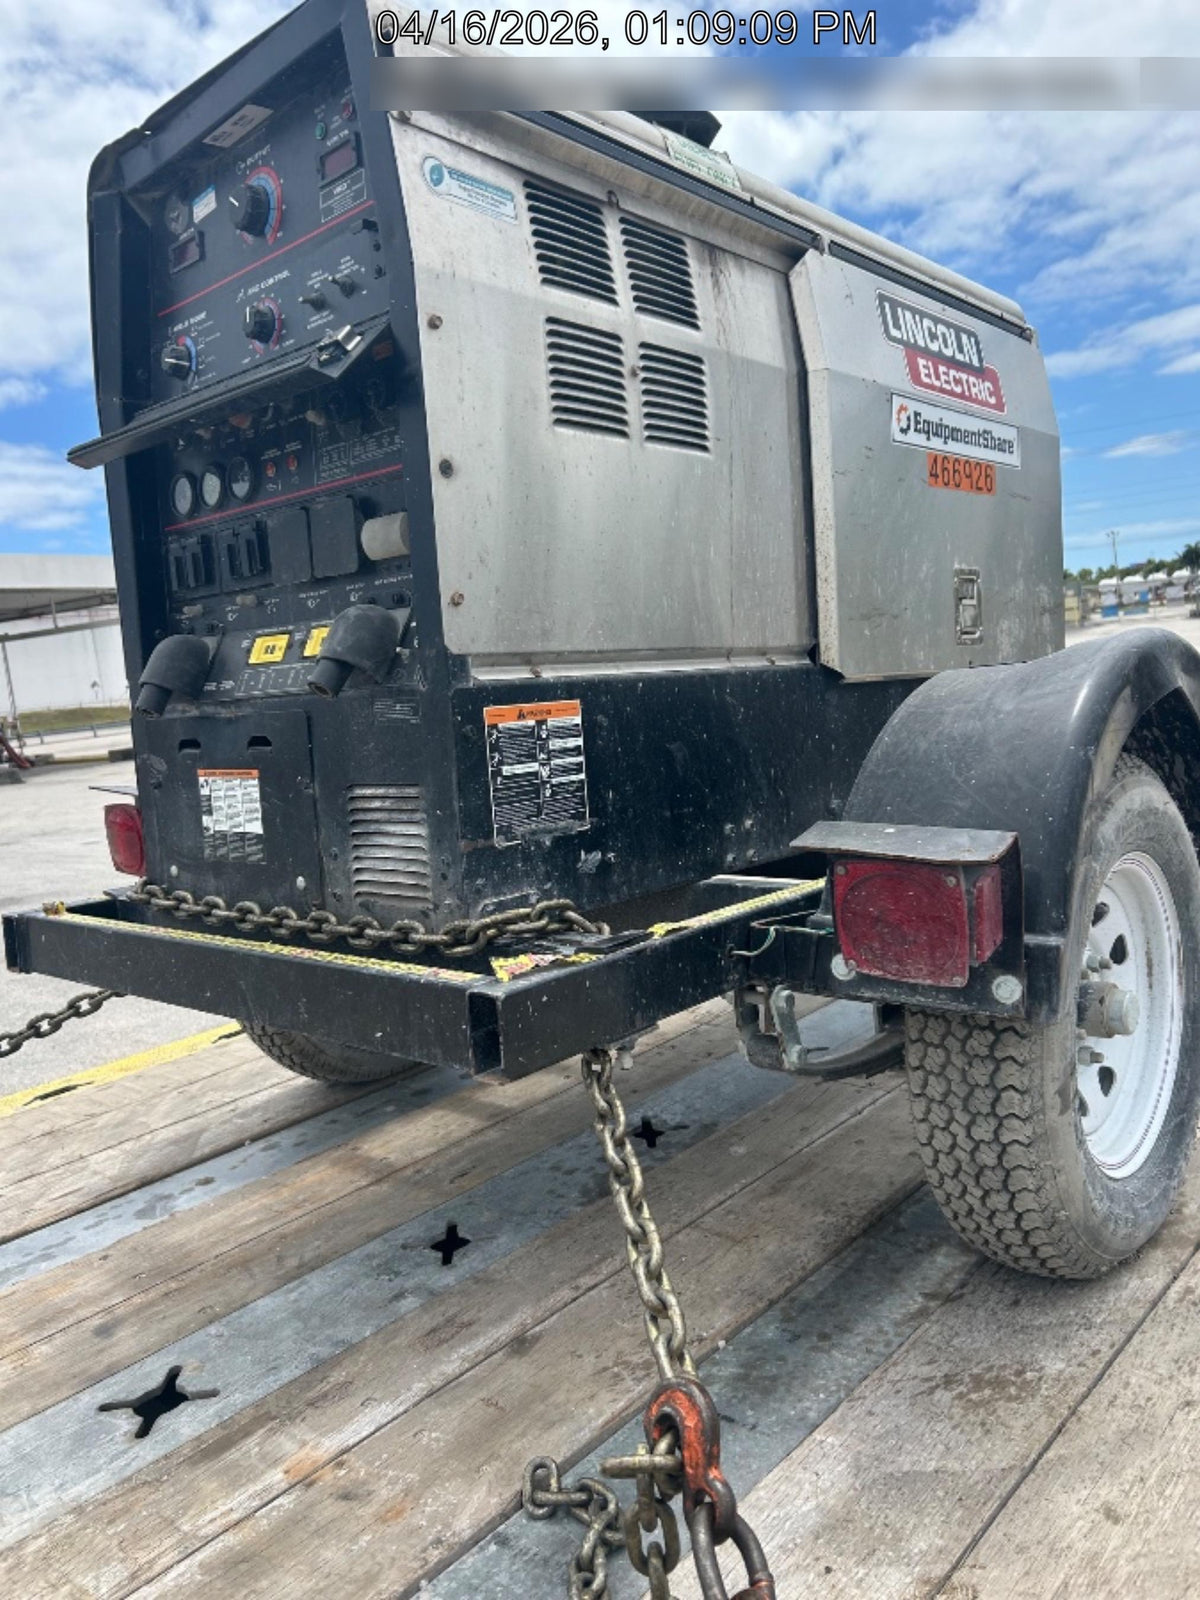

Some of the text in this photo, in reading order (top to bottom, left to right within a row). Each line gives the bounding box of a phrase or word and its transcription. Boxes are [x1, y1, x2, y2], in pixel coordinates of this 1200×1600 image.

[883, 301, 981, 367] LINCOLN
[917, 357, 996, 405] ELECTRIC
[913, 410, 1015, 455] EquipmentShare
[929, 455, 994, 493] 466926
